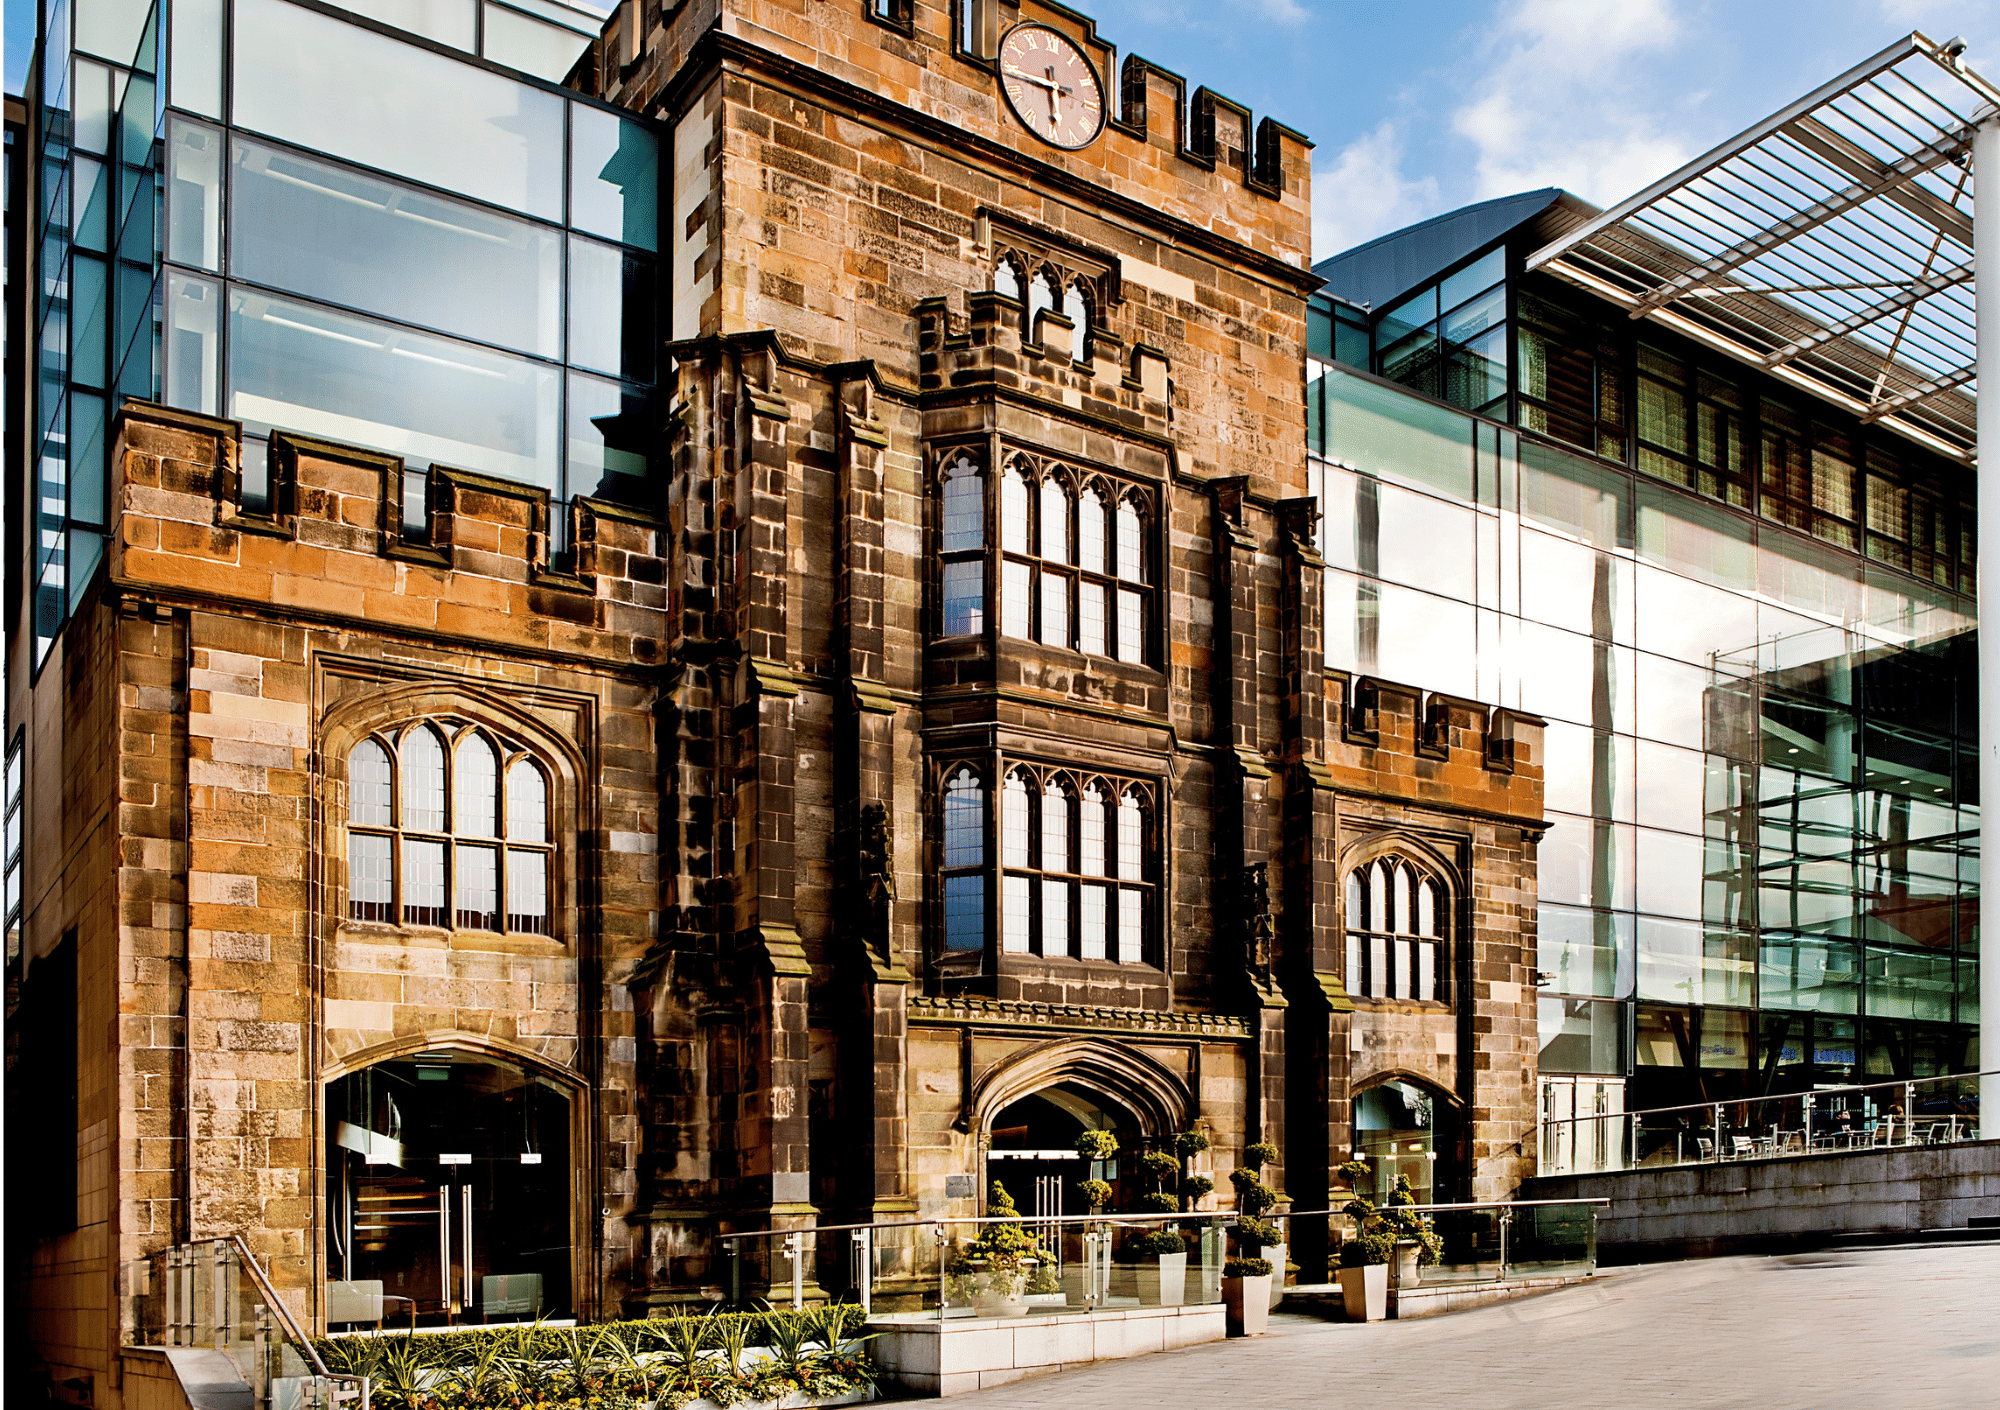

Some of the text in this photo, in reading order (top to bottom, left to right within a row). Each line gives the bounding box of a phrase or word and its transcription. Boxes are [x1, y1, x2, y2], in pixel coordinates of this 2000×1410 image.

[1008, 40, 1025, 59] X
[1023, 33, 1038, 50] XI
[1045, 34, 1059, 55] XII
